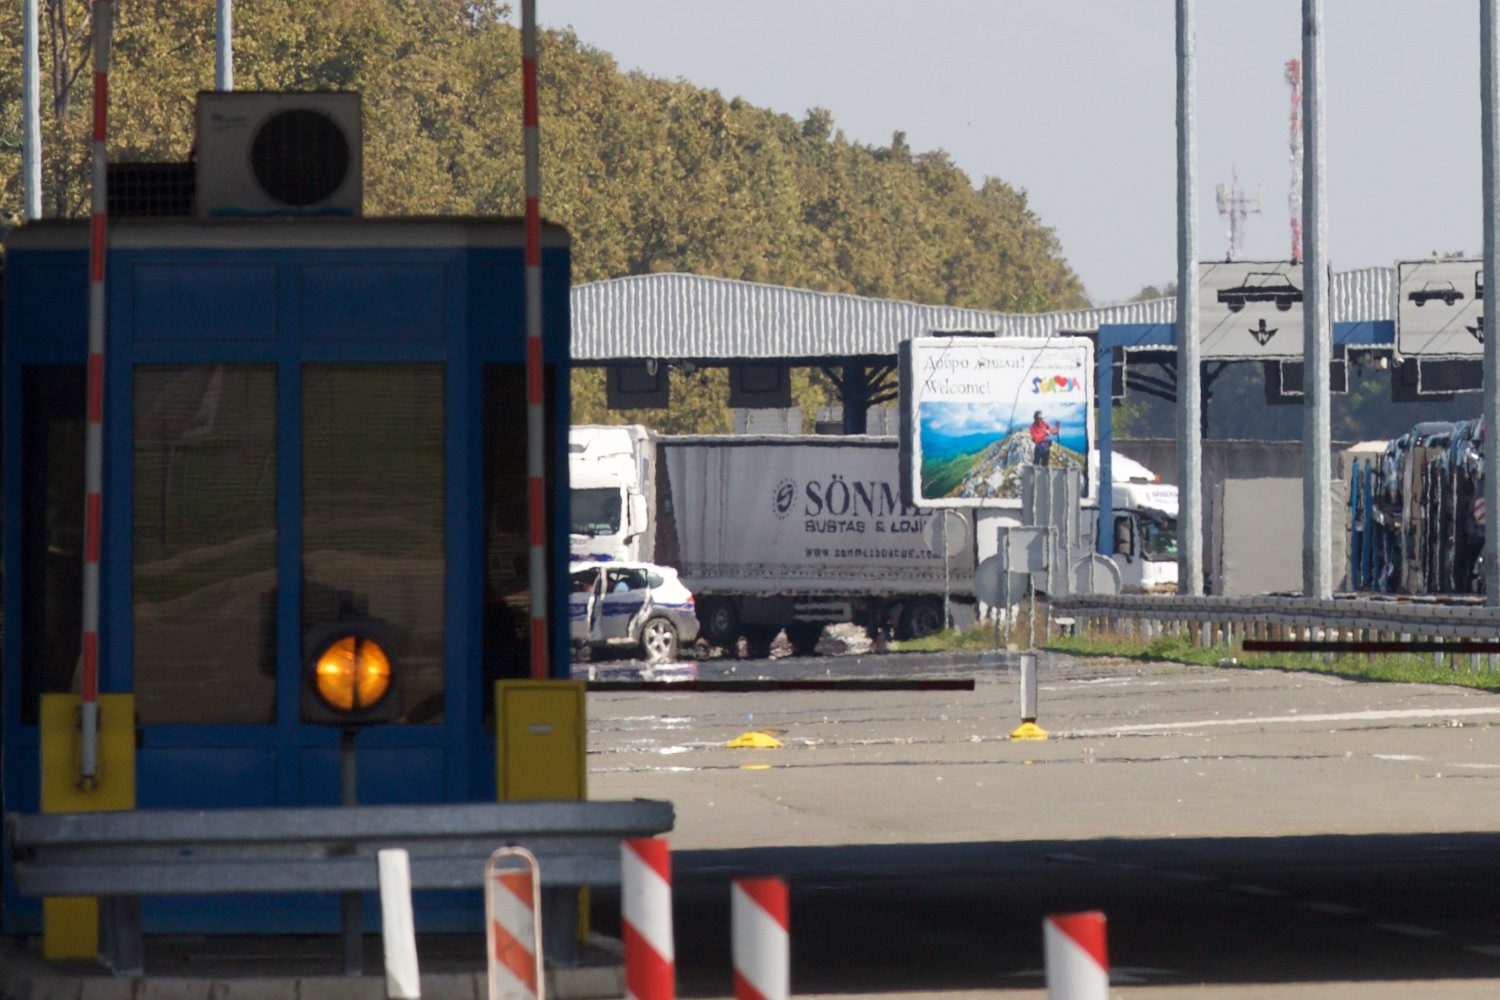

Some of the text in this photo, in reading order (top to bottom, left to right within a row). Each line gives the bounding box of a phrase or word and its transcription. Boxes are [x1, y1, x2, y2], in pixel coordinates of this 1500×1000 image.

[923, 353, 970, 374] Добро
[924, 378, 991, 394] Welcome!
[804, 474, 933, 517] SÖNM
[875, 520, 886, 533] &
